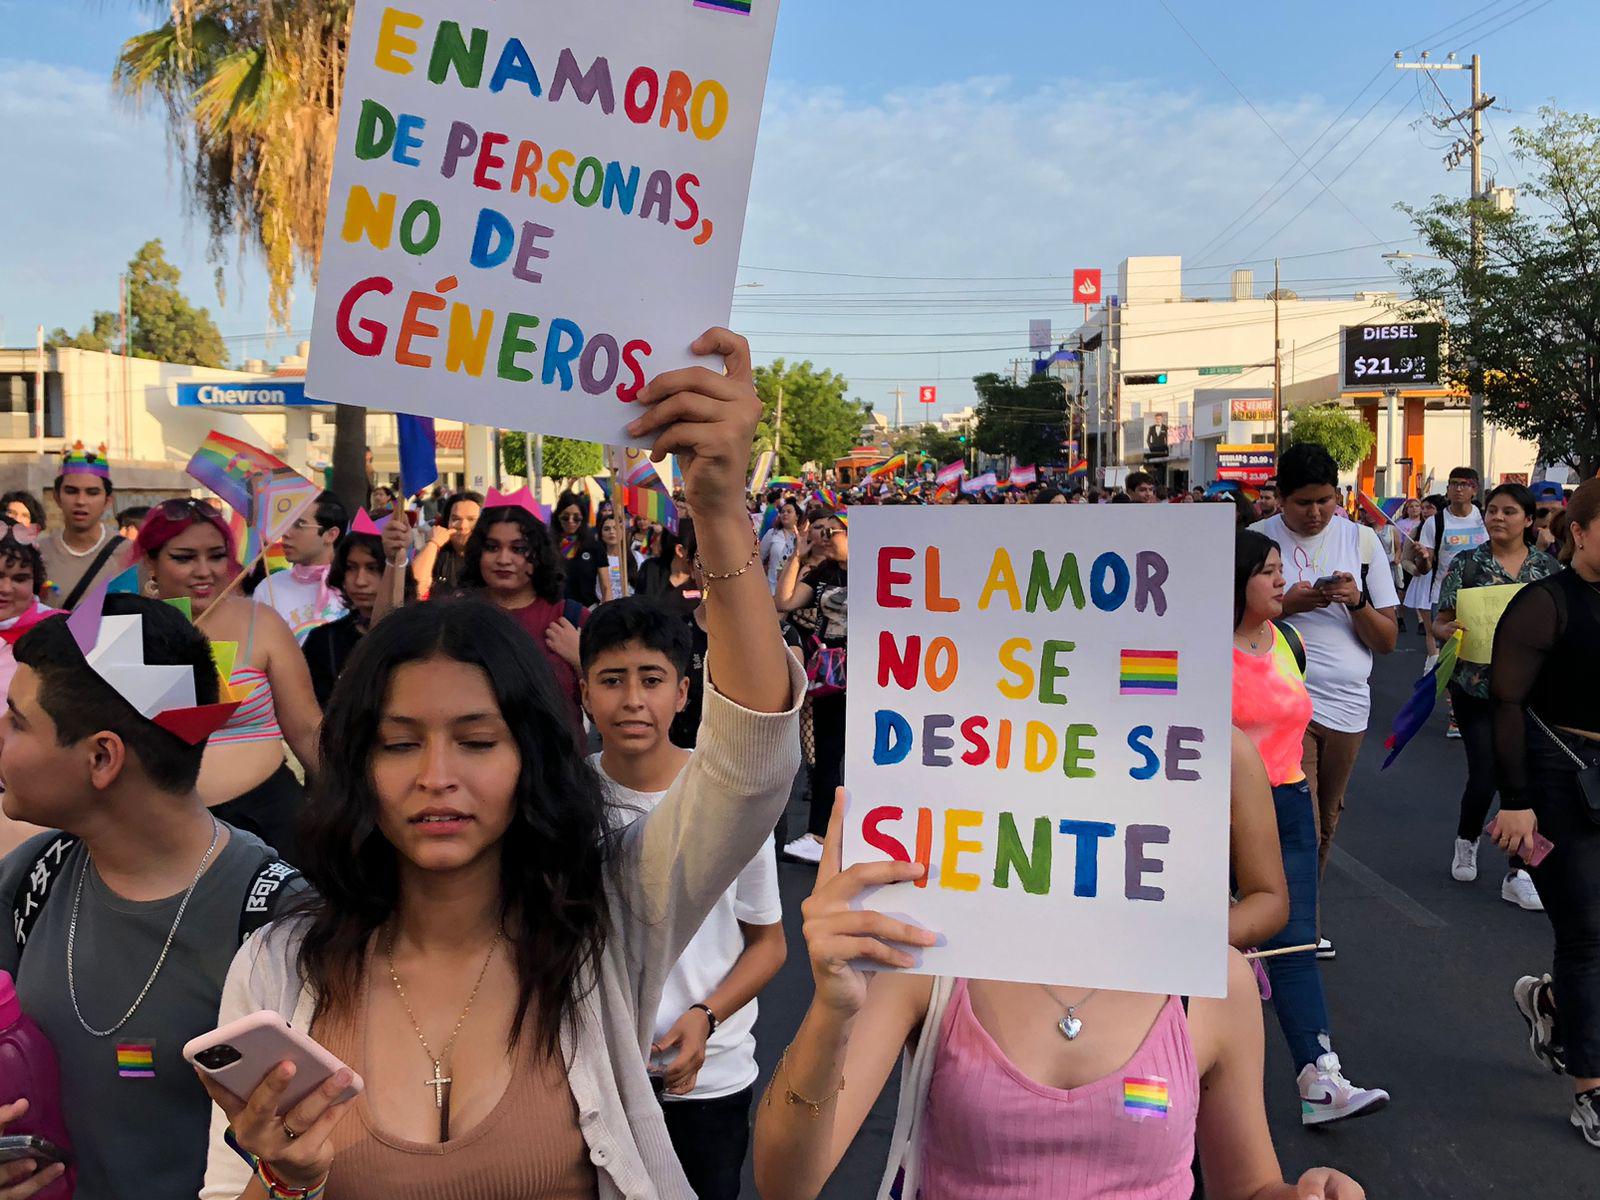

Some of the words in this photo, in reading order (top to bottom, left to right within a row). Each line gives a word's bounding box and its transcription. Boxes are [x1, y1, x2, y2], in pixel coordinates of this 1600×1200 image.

[375, 7, 729, 141] ENAMORO
[355, 99, 426, 168] DE
[440, 121, 713, 246] PERSONAS,
[341, 185, 441, 257] NO
[469, 208, 555, 283] DE
[336, 276, 652, 402] GÉNEROS
[1363, 325, 1418, 340] DIESEL
[197, 385, 285, 404] Chevron
[876, 546, 961, 612] EL
[978, 547, 1169, 617] AMOR
[877, 631, 958, 693] NO
[996, 637, 1076, 705] SE
[873, 710, 1098, 778] DESIDE
[1127, 725, 1205, 781] SE
[862, 806, 1171, 901] SIENTE
